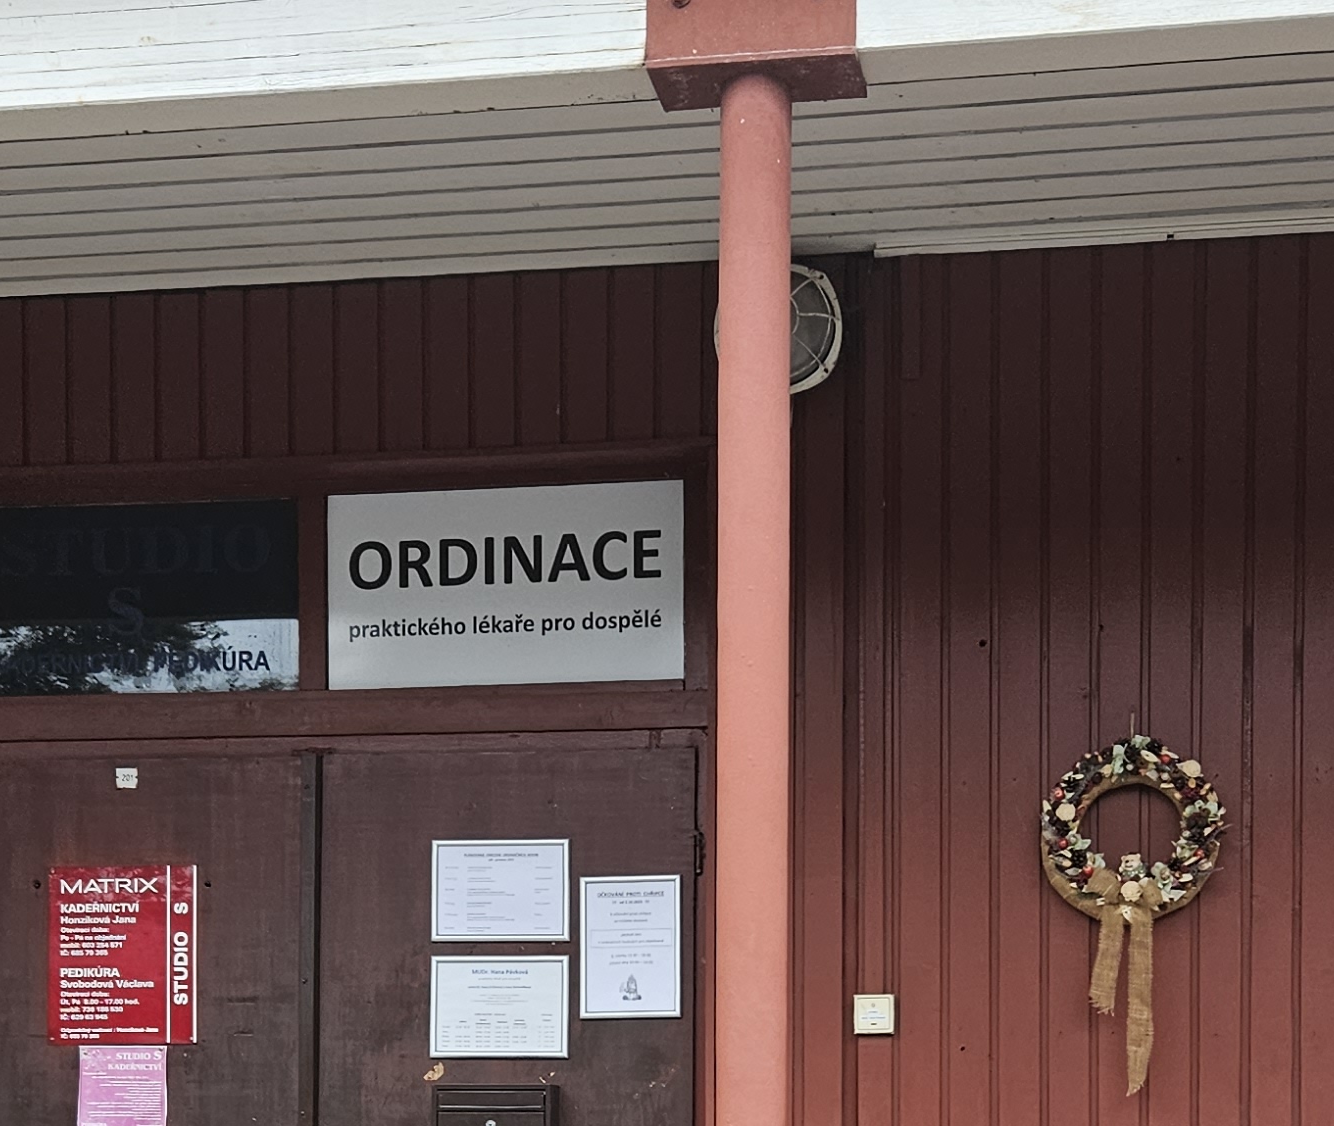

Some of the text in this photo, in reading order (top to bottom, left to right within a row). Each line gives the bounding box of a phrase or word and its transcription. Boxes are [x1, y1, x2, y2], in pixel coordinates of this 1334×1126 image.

[348, 529, 663, 590] ORDINACE
[107, 586, 145, 637] S
[348, 608, 663, 643] praktického lékaře pro dospělé
[60, 877, 159, 895] MATRIX
[60, 901, 140, 914] KADEŘNICTVÍ
[111, 915, 137, 924] Jana
[173, 902, 189, 1006] STUDIO S
[60, 965, 120, 978] PEDIKÚRA
[60, 980, 114, 989] Svobodová
